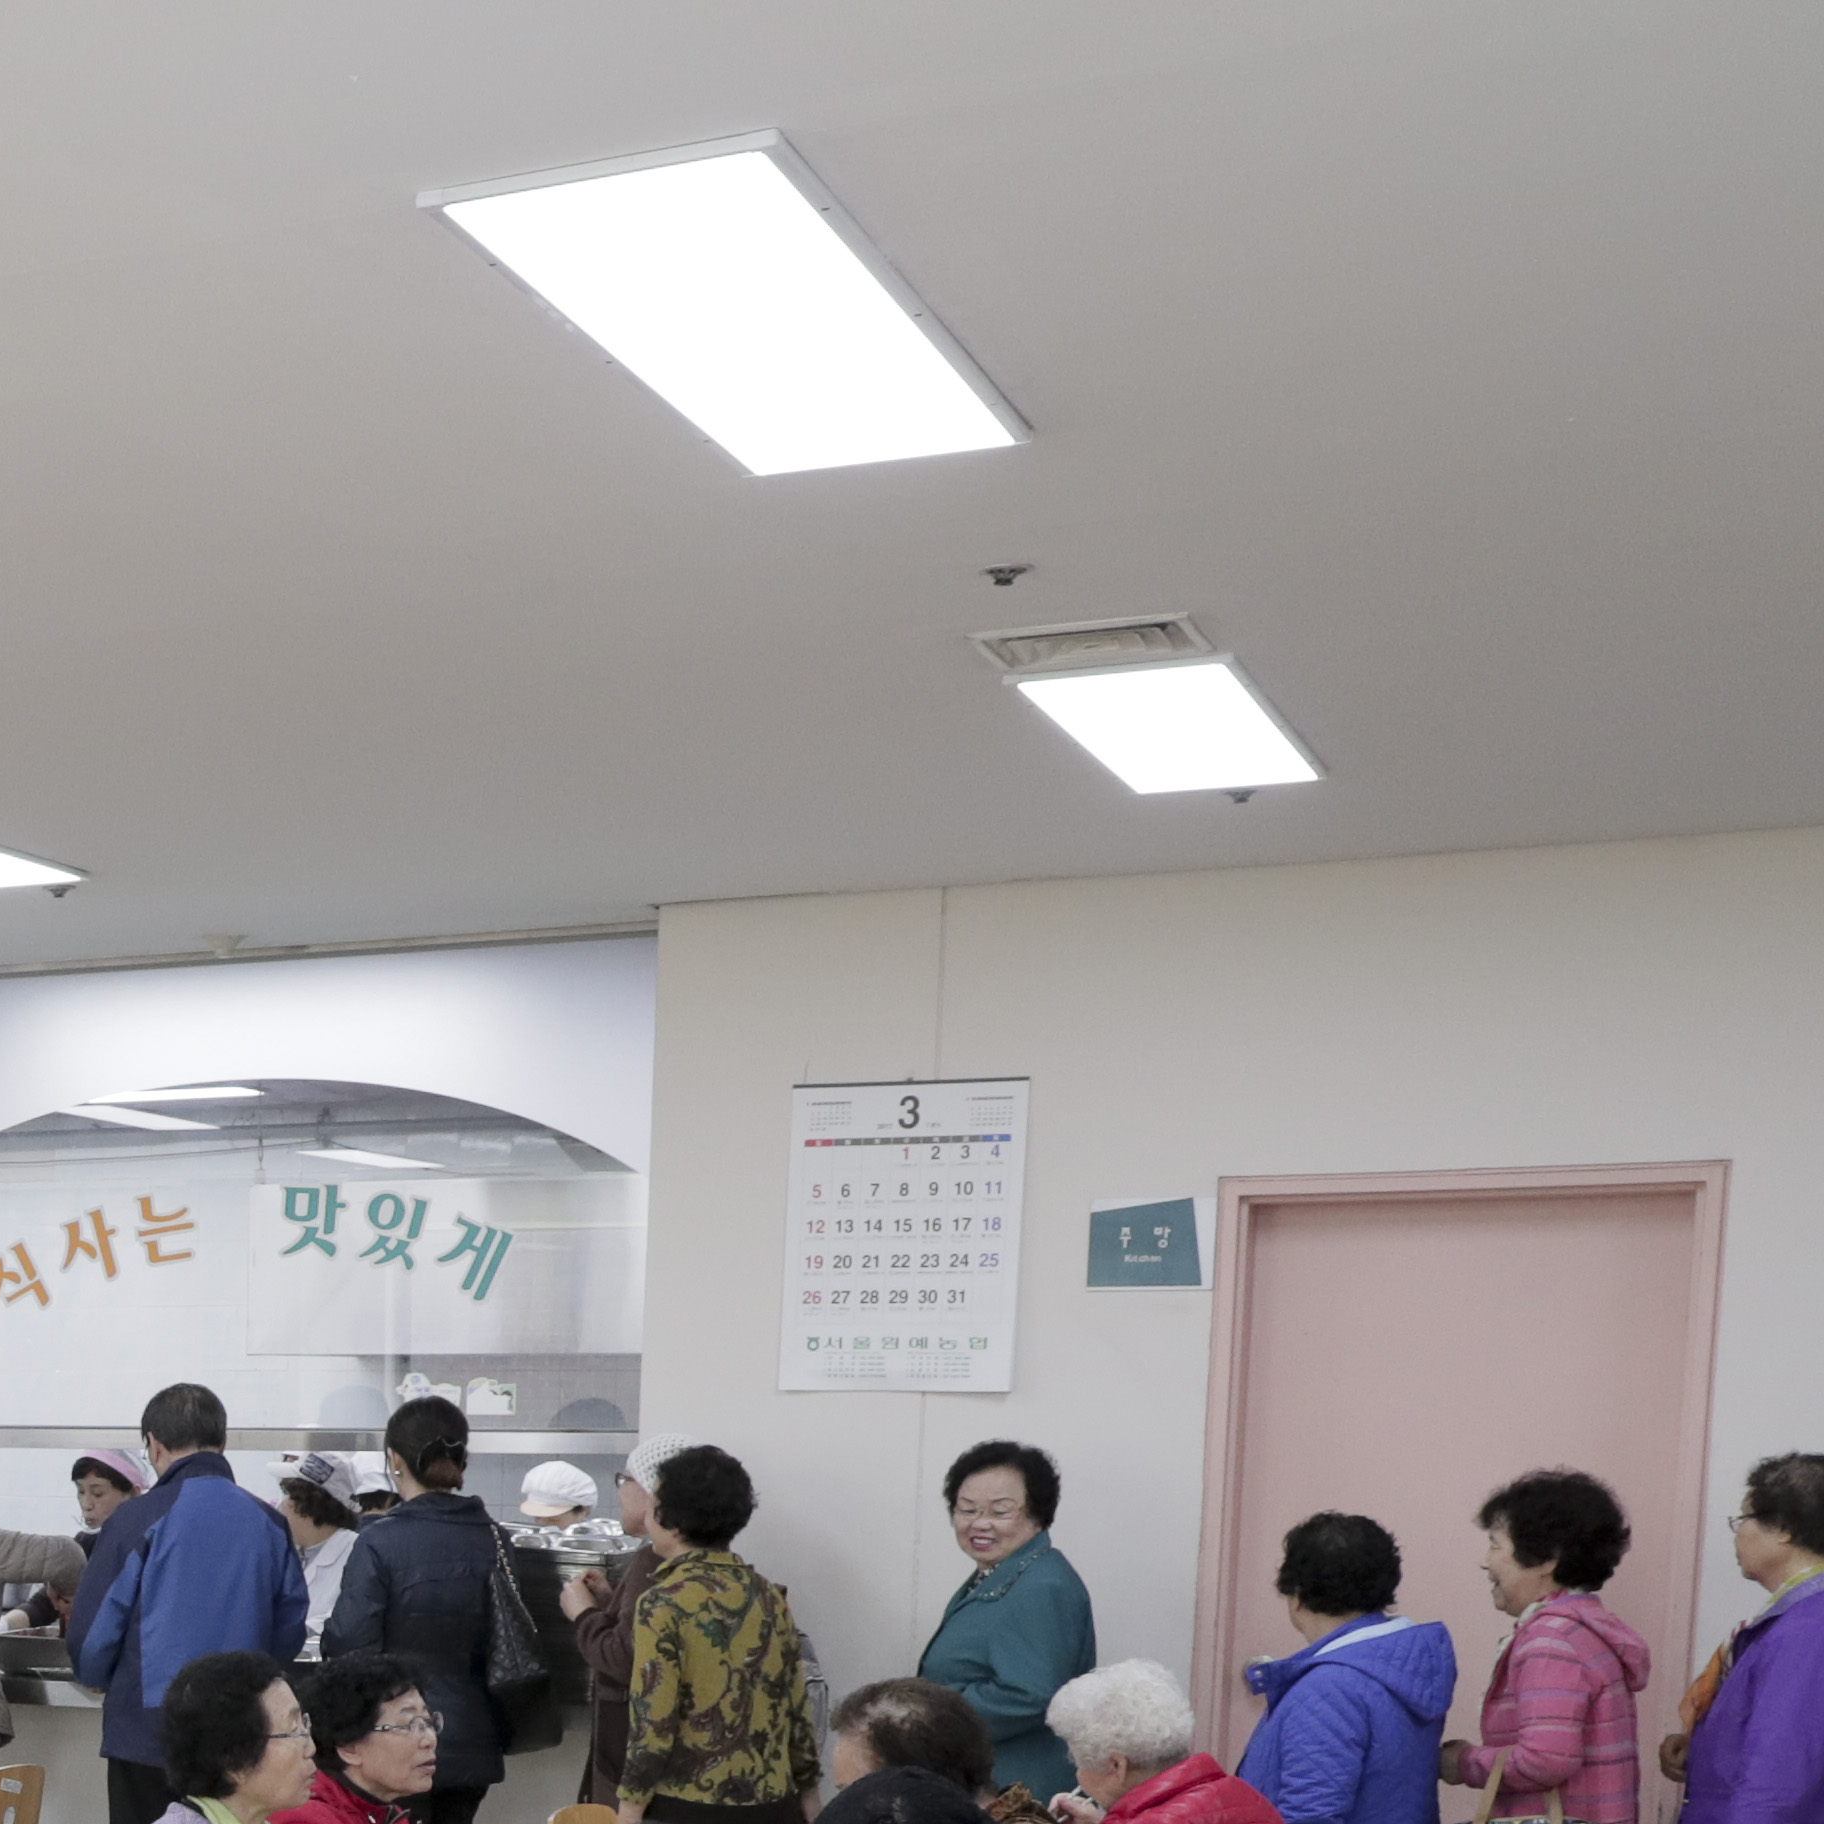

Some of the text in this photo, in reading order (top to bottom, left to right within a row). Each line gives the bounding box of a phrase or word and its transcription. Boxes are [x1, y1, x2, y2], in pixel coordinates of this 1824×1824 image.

[898, 1095, 920, 1129] 3
[902, 1144, 1001, 1160] 1 2 3 4
[812, 1180, 1002, 1199] 5 6 7 8 9 10 11
[806, 1217, 1002, 1235] 12 13 14 15 16 17 18
[282, 1184, 512, 1300] 맛있게
[805, 1253, 1000, 1269] 19 20 21 22 23 24 25
[1124, 1254, 1162, 1263] Kitchen
[802, 1289, 967, 1305] 26 27 28 29 30 31
